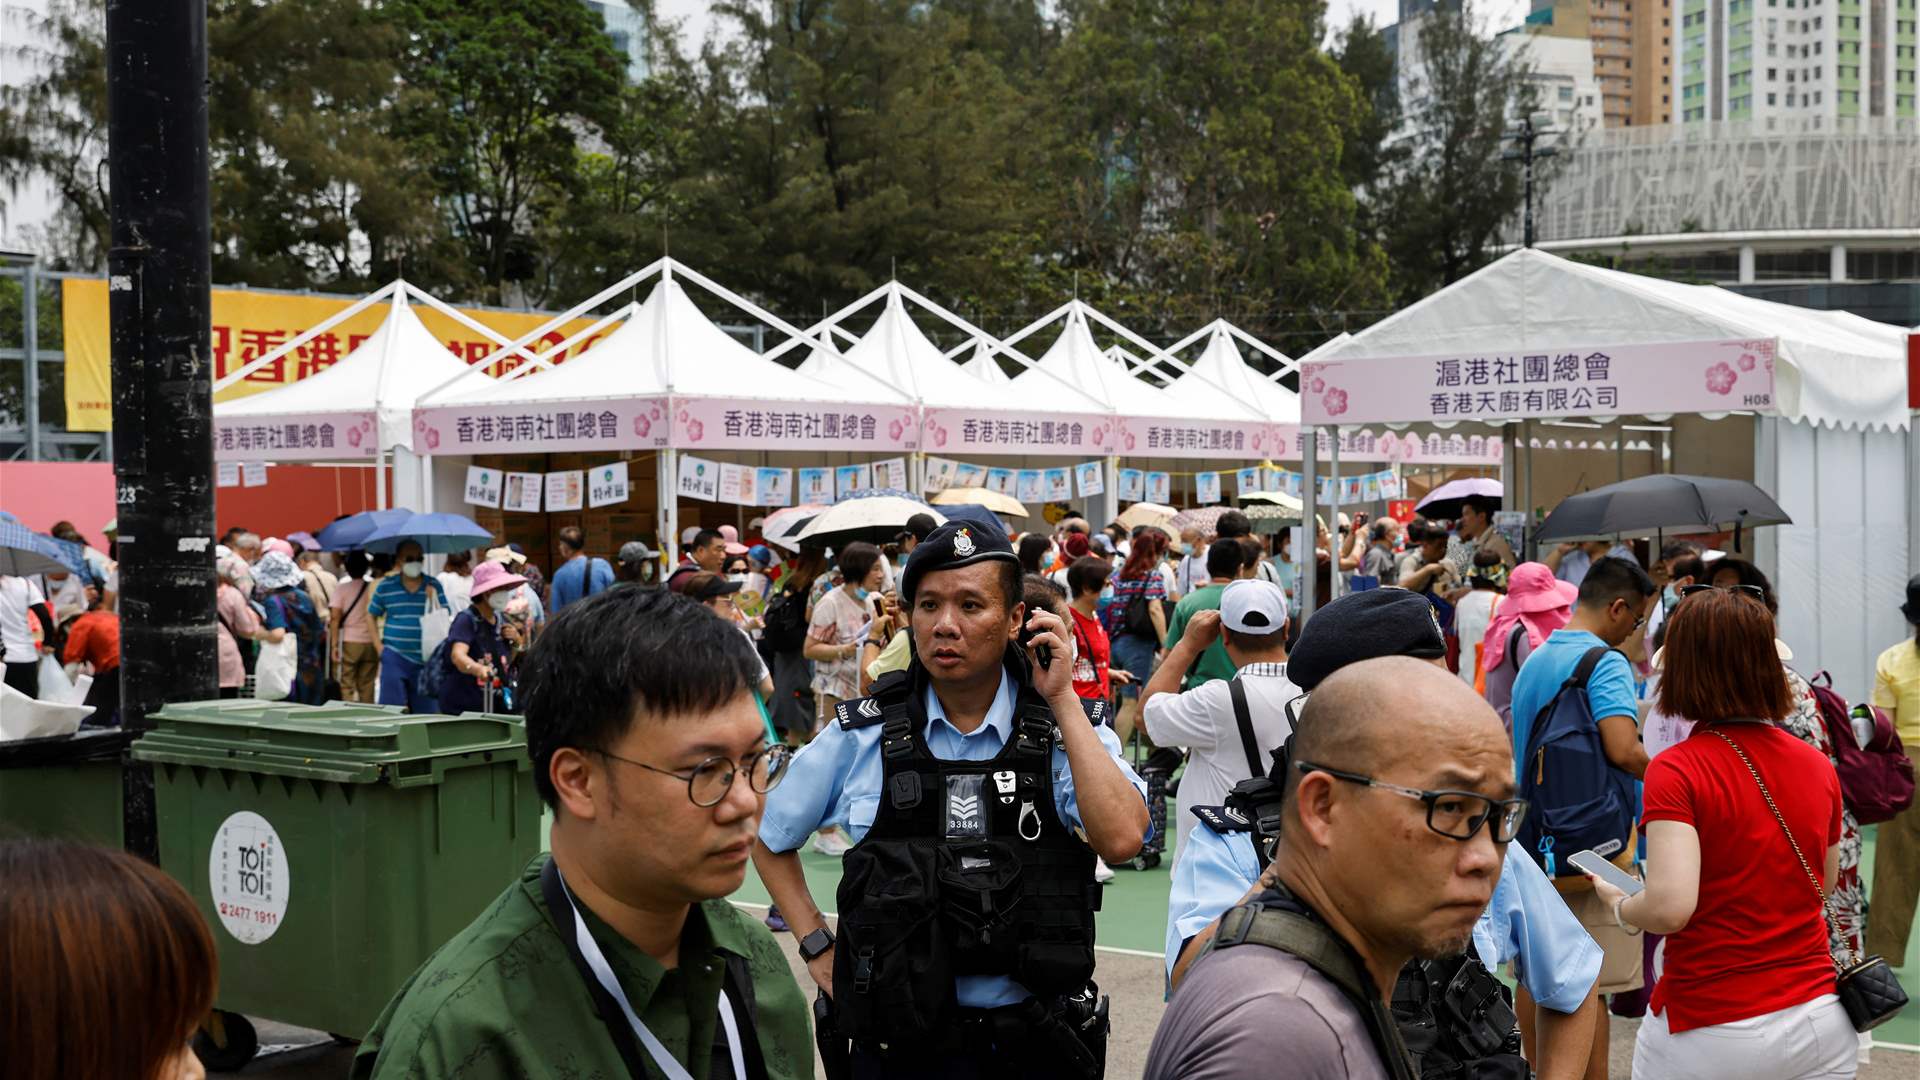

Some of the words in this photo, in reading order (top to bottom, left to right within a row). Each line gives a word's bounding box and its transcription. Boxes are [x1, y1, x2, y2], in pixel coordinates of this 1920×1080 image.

[1436, 352, 1611, 387] 滬港社團總會
[1429, 386, 1618, 415] 香港天廚有限公司
[1743, 394, 1770, 406] H08
[212, 423, 335, 450] 港海南社團總會
[457, 410, 618, 443] 香港海南社團總會
[724, 410, 877, 440] 香港海南社團總會
[962, 418, 1083, 446] 香港海南社團總會
[1147, 426, 1244, 450] 香港海南社團總會
[837, 704, 850, 724] 33884
[950, 820, 979, 829] 33884
[238, 869, 264, 896] TOI
[229, 904, 251, 920] 2477
[254, 911, 278, 925] 1911
